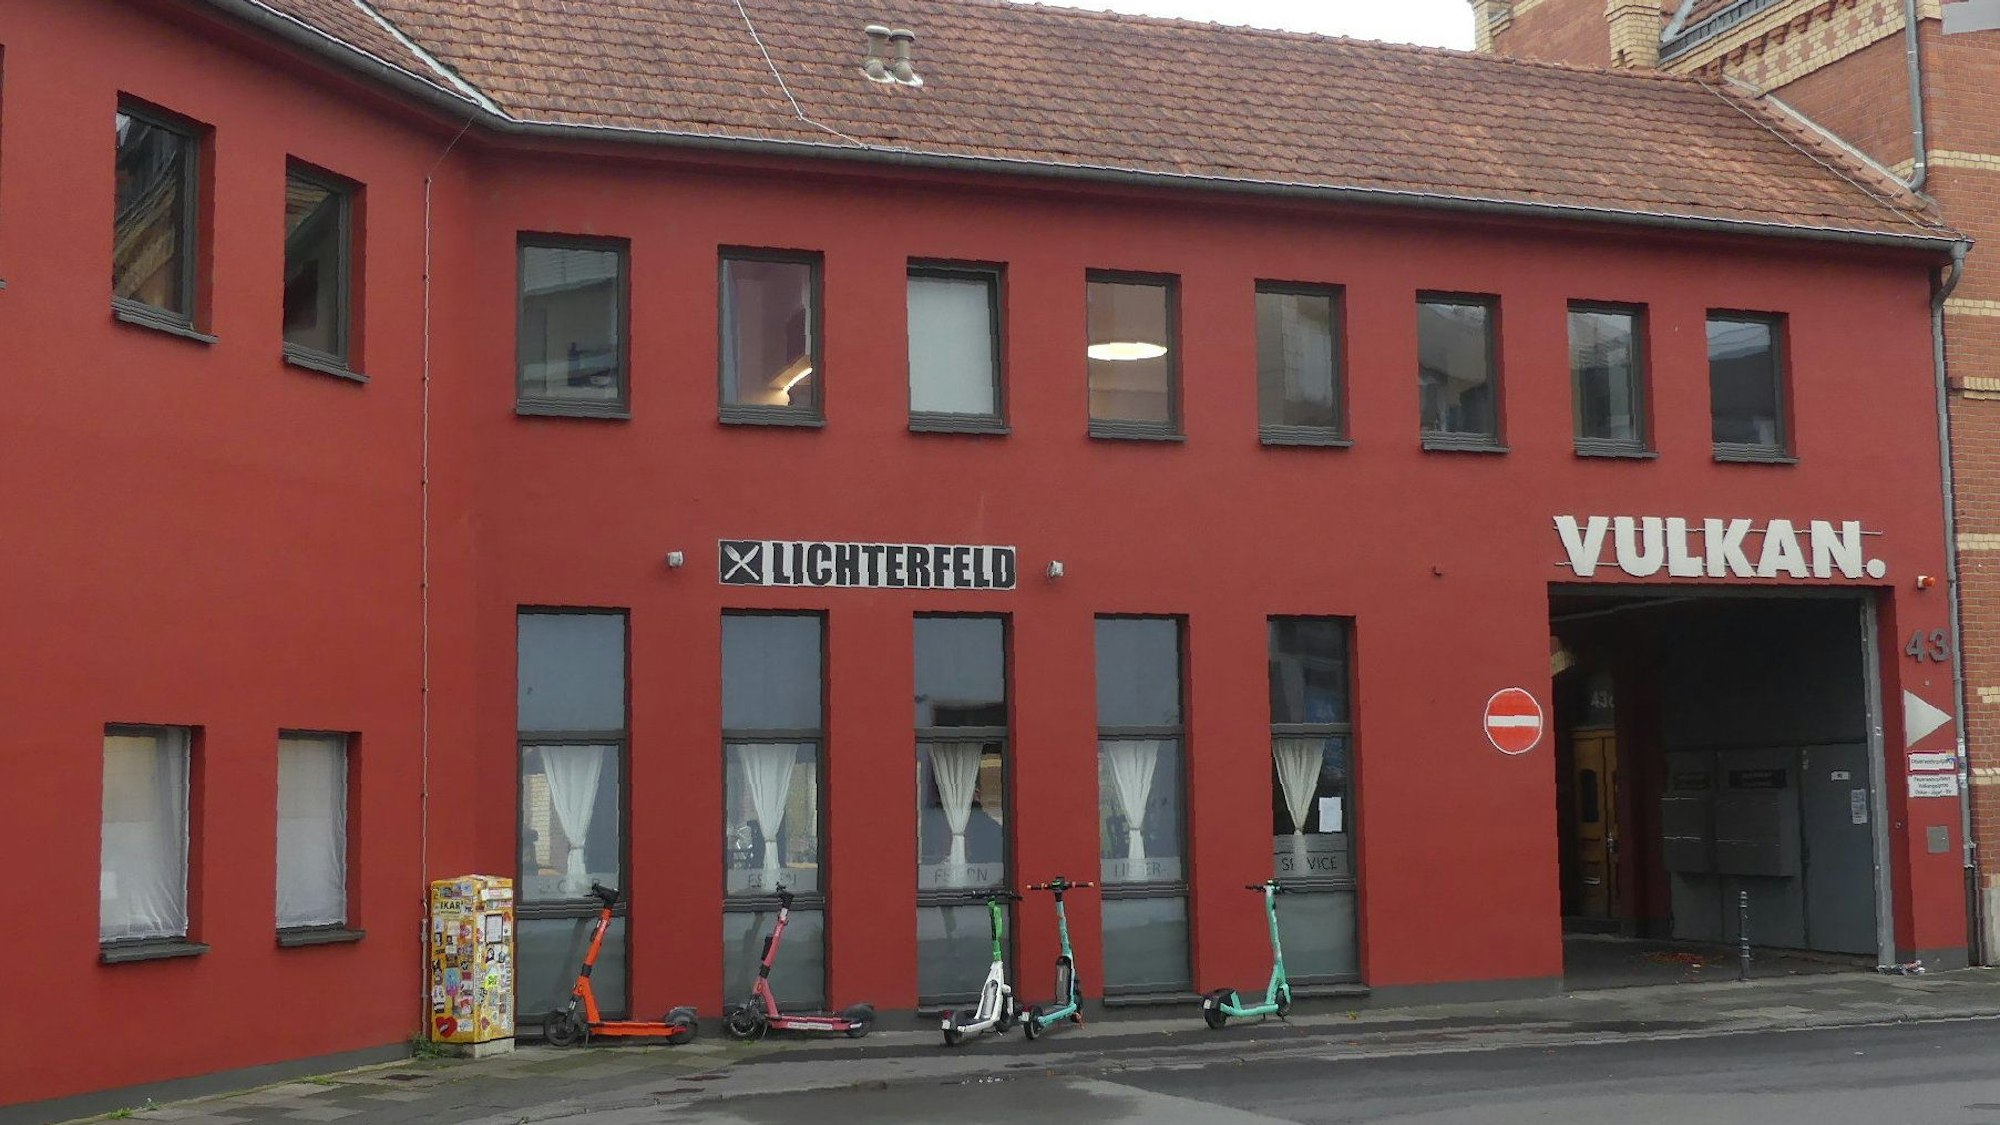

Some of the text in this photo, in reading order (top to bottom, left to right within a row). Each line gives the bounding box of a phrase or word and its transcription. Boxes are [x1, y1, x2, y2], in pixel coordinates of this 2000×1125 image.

[772, 541, 1015, 589] LICHTERFELD
[1553, 515, 1886, 579] VULKAN.
[1905, 628, 1950, 662] 43
